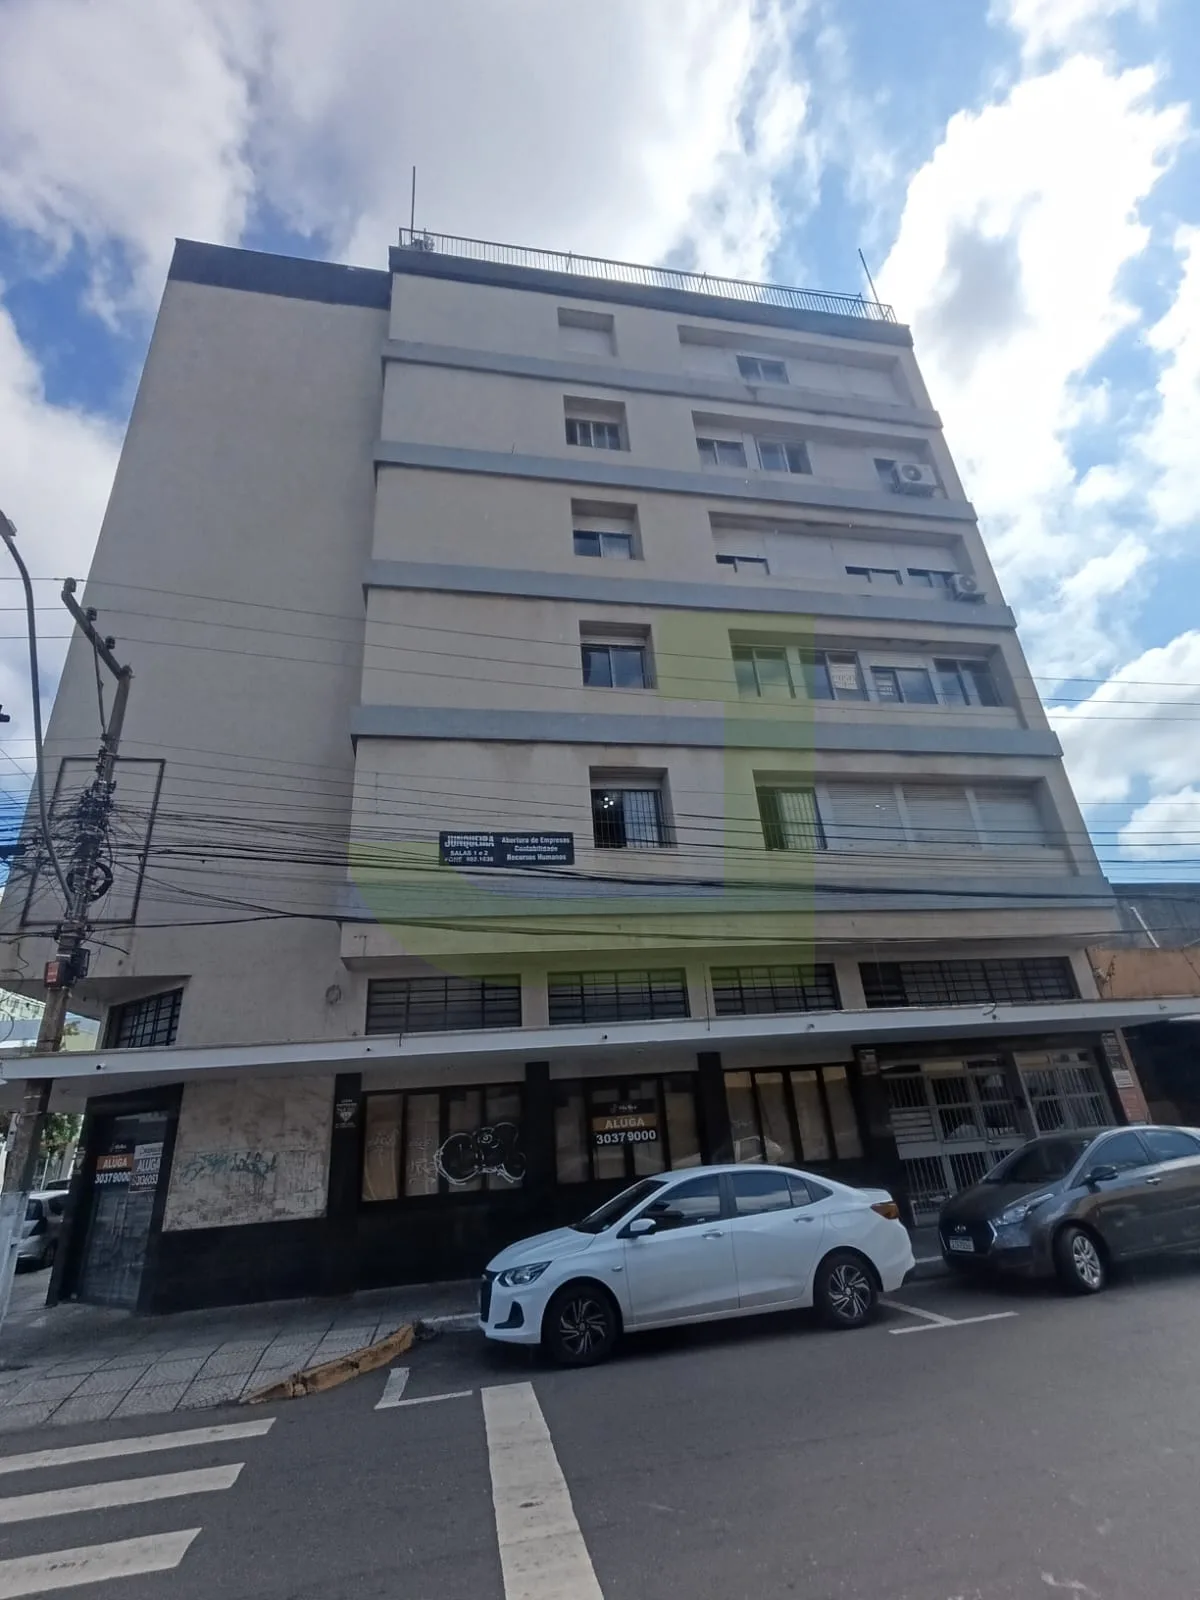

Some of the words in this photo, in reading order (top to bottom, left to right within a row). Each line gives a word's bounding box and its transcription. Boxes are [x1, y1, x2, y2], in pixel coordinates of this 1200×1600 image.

[501, 836, 529, 844] Abertura
[540, 836, 570, 844] Empresas
[604, 1117, 645, 1129] ALUGA
[596, 1129, 657, 1145] 30379000
[102, 1157, 128, 1169] ALUGA
